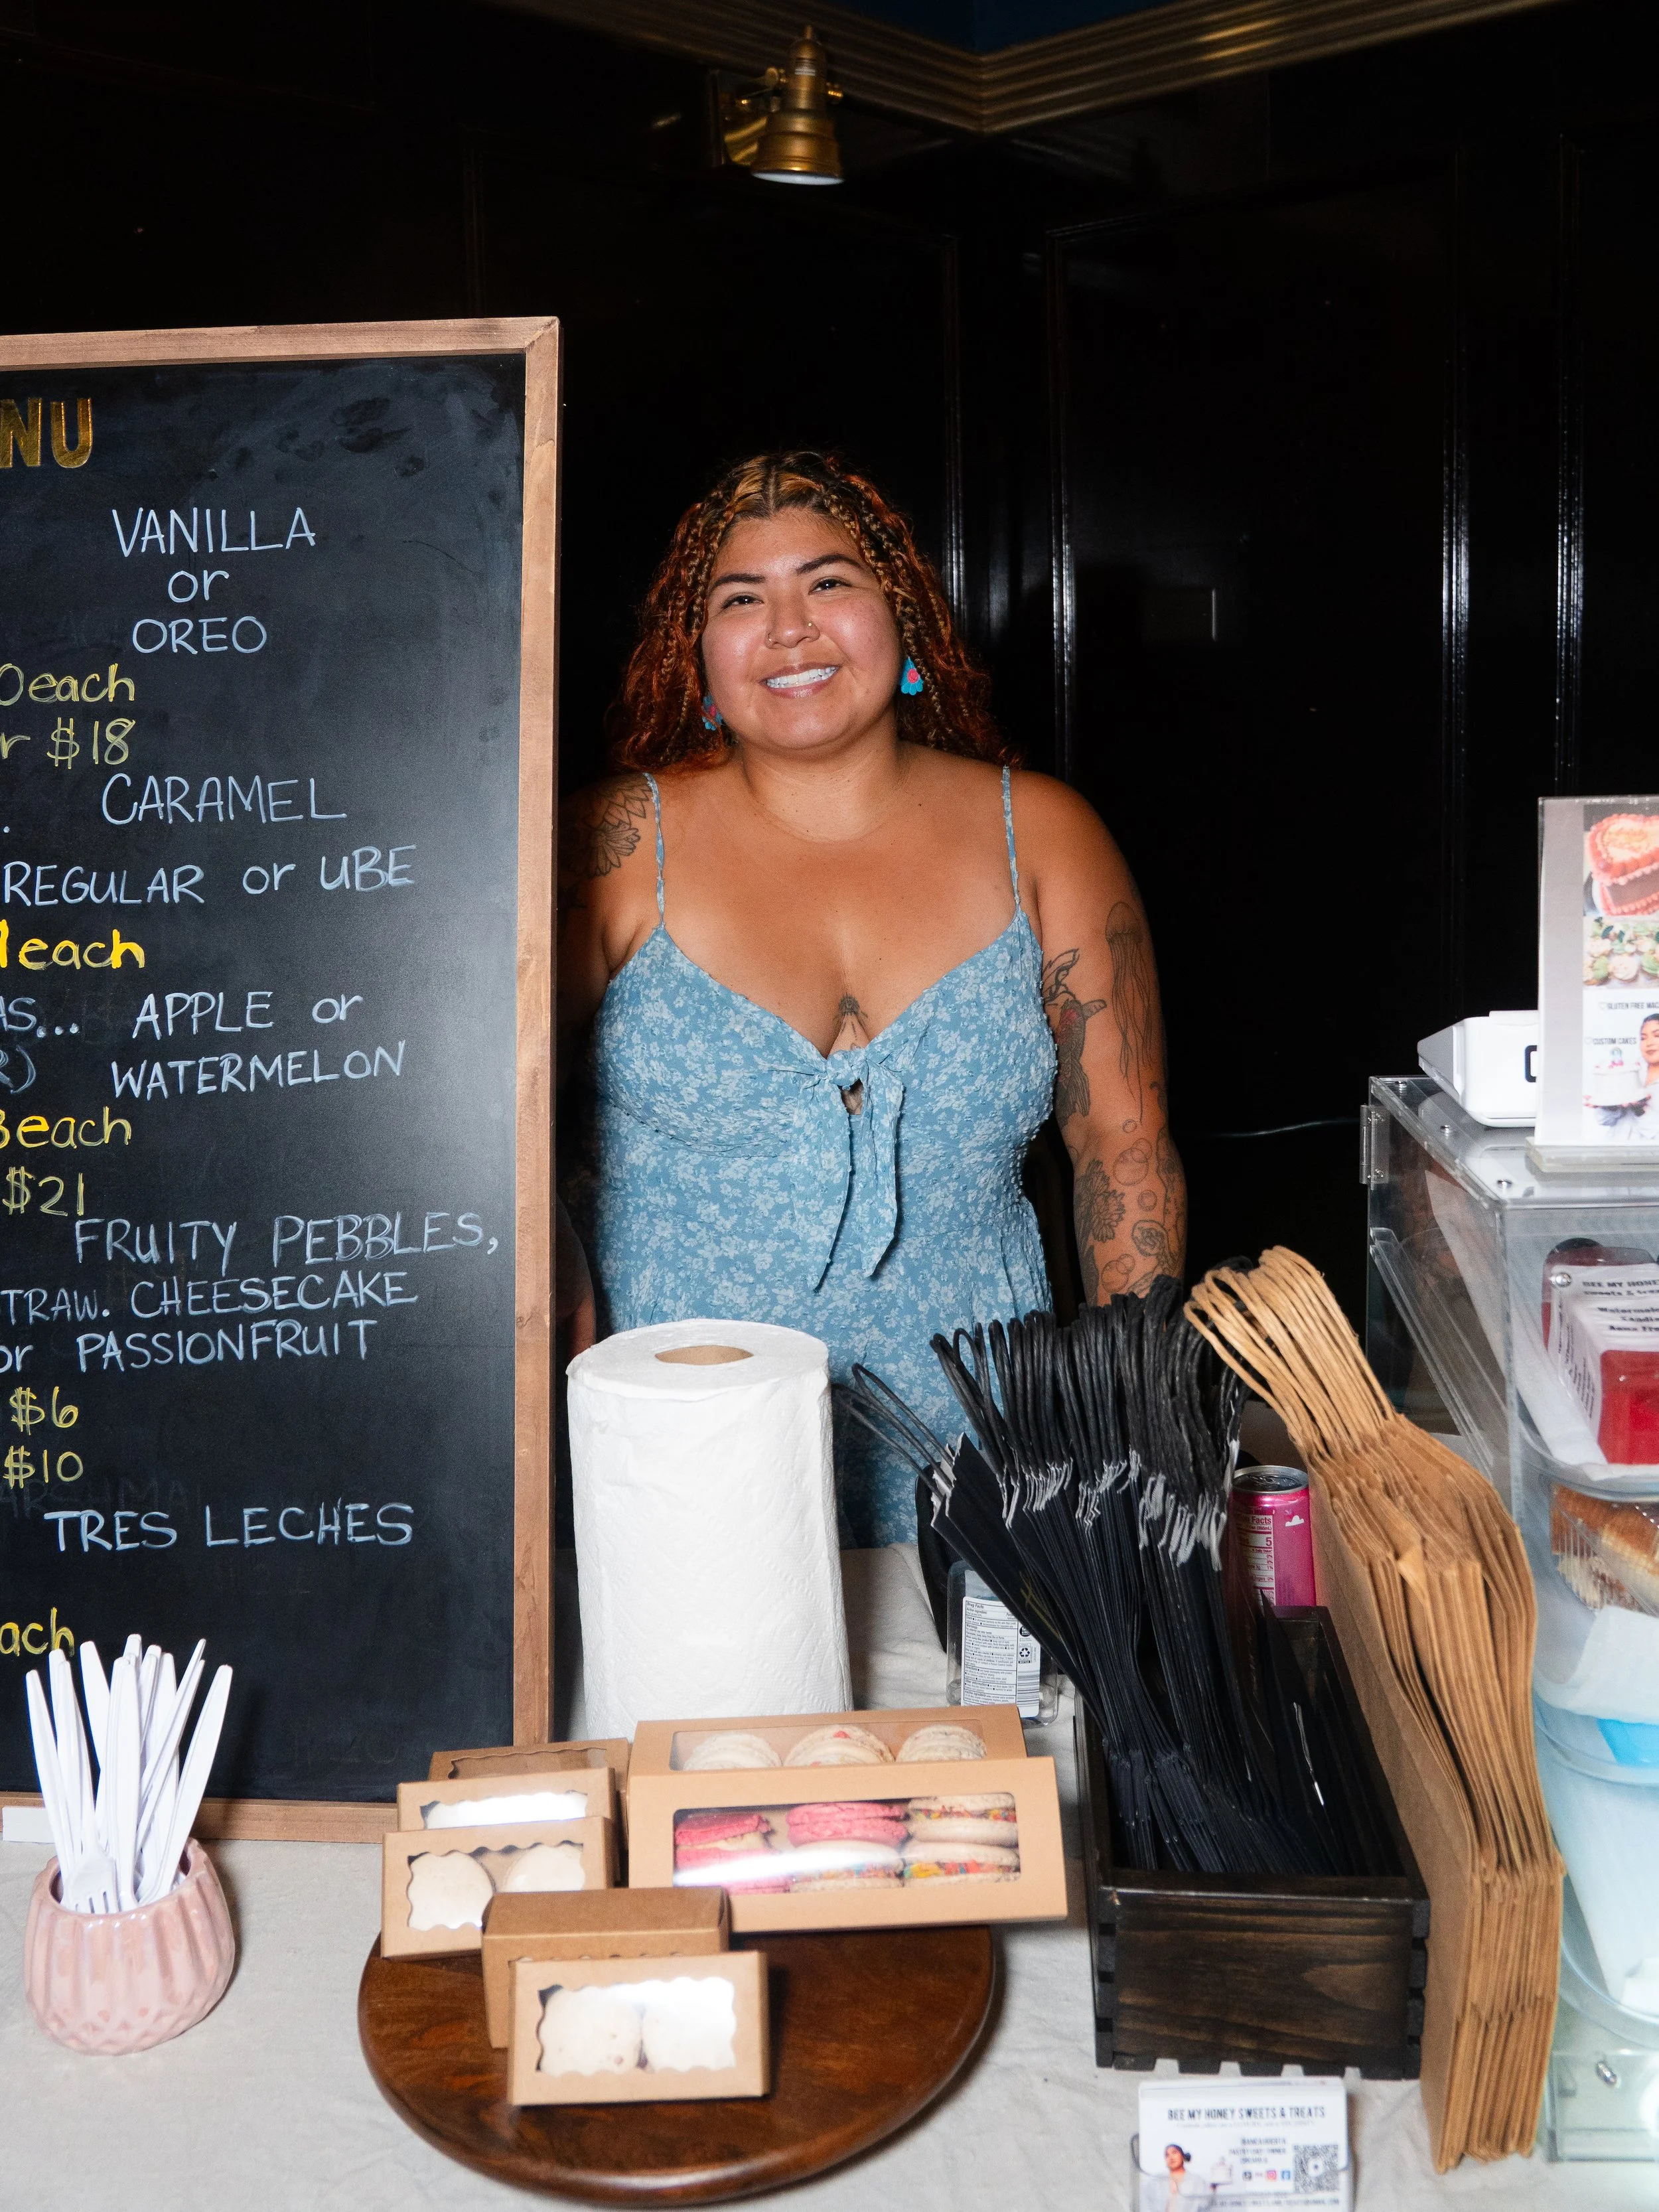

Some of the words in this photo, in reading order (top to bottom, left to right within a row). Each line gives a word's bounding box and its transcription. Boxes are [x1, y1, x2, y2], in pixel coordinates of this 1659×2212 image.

[0, 398, 93, 469] NU
[111, 506, 316, 557] VANILLA
[167, 569, 230, 603] or
[132, 615, 267, 655] OREO
[46, 717, 136, 770] $18
[102, 773, 348, 825] CARAMEL
[3, 861, 205, 907] REGULAR
[242, 862, 297, 895] or
[320, 844, 417, 892] UBE
[132, 991, 275, 1041] APPLE
[311, 994, 364, 1024] or
[111, 1039, 405, 1100] WATERMELON
[2, 1165, 84, 1217] $21
[74, 1218, 240, 1277] FRUITY
[273, 1212, 498, 1268] PEBBLES,
[131, 1270, 419, 1318] CHEESECAKE
[76, 1318, 378, 1373] PASSIONFRUIT
[9, 1386, 79, 1436] $6
[2, 1445, 84, 1489] $10
[43, 1509, 177, 1552] TRES
[205, 1497, 414, 1548] LECHES
[1252, 1516, 1271, 1524] Facts
[1265, 1537, 1272, 1546] 5
[1167, 2108, 1185, 2121] BEE
[1187, 2108, 1202, 2120] MY
[1204, 2107, 1236, 2120] HONEY
[1238, 2106, 1277, 2120] SWEETS
[1279, 2106, 1285, 2118] &
[1289, 2105, 1326, 2119] TREATS
